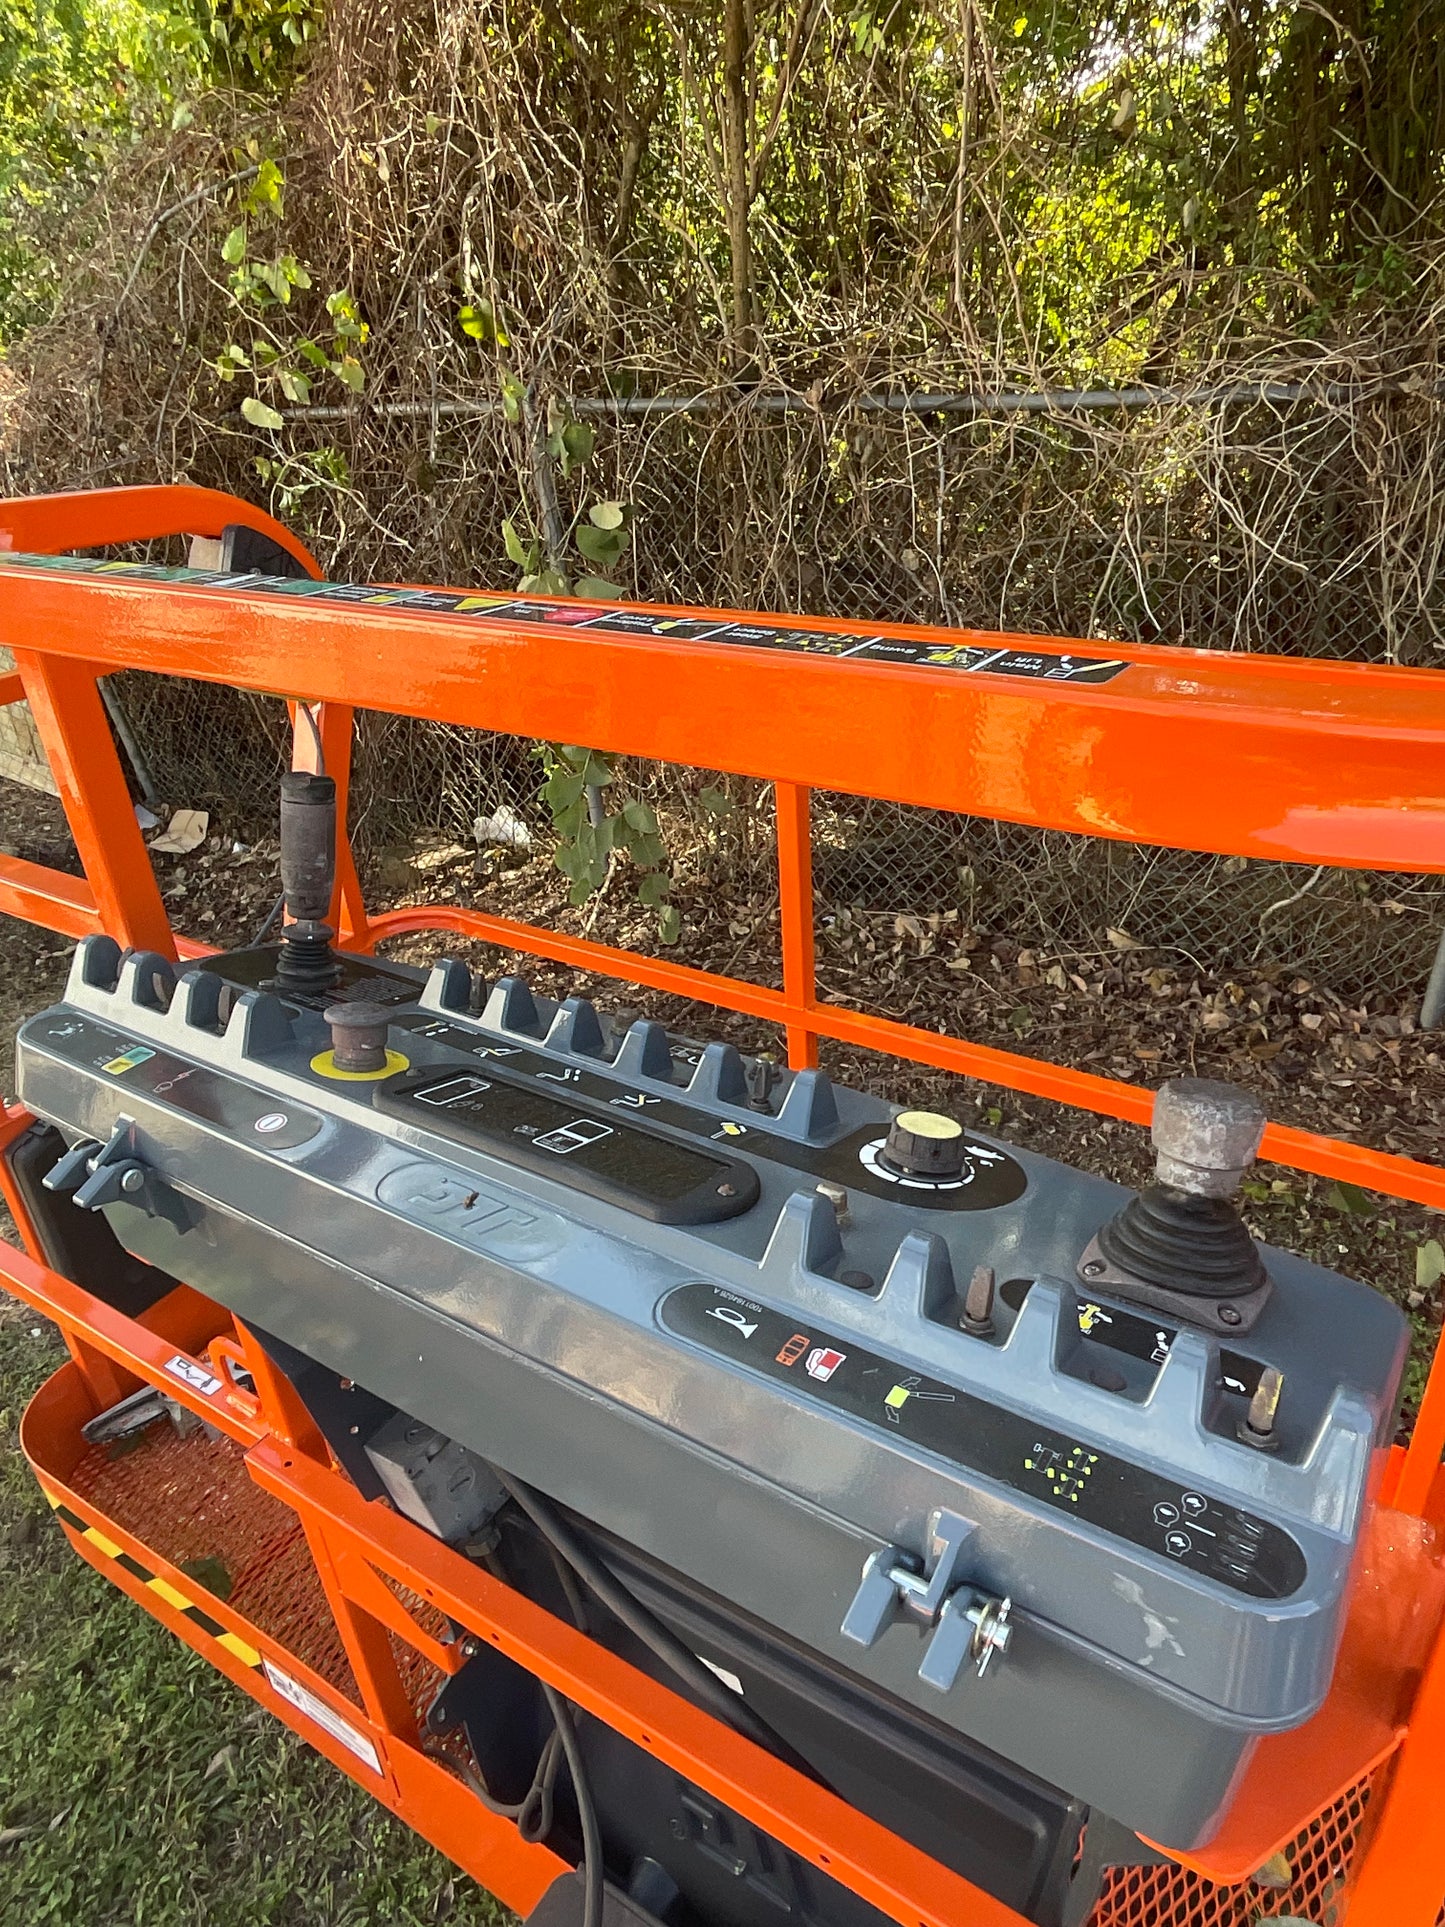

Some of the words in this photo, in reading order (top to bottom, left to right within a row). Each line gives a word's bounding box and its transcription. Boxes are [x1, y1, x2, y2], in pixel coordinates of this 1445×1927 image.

[869, 644, 917, 655] Swing
[1014, 655, 1043, 664] Lift
[999, 661, 1043, 670] Main
[407, 1177, 541, 1240] JLG
